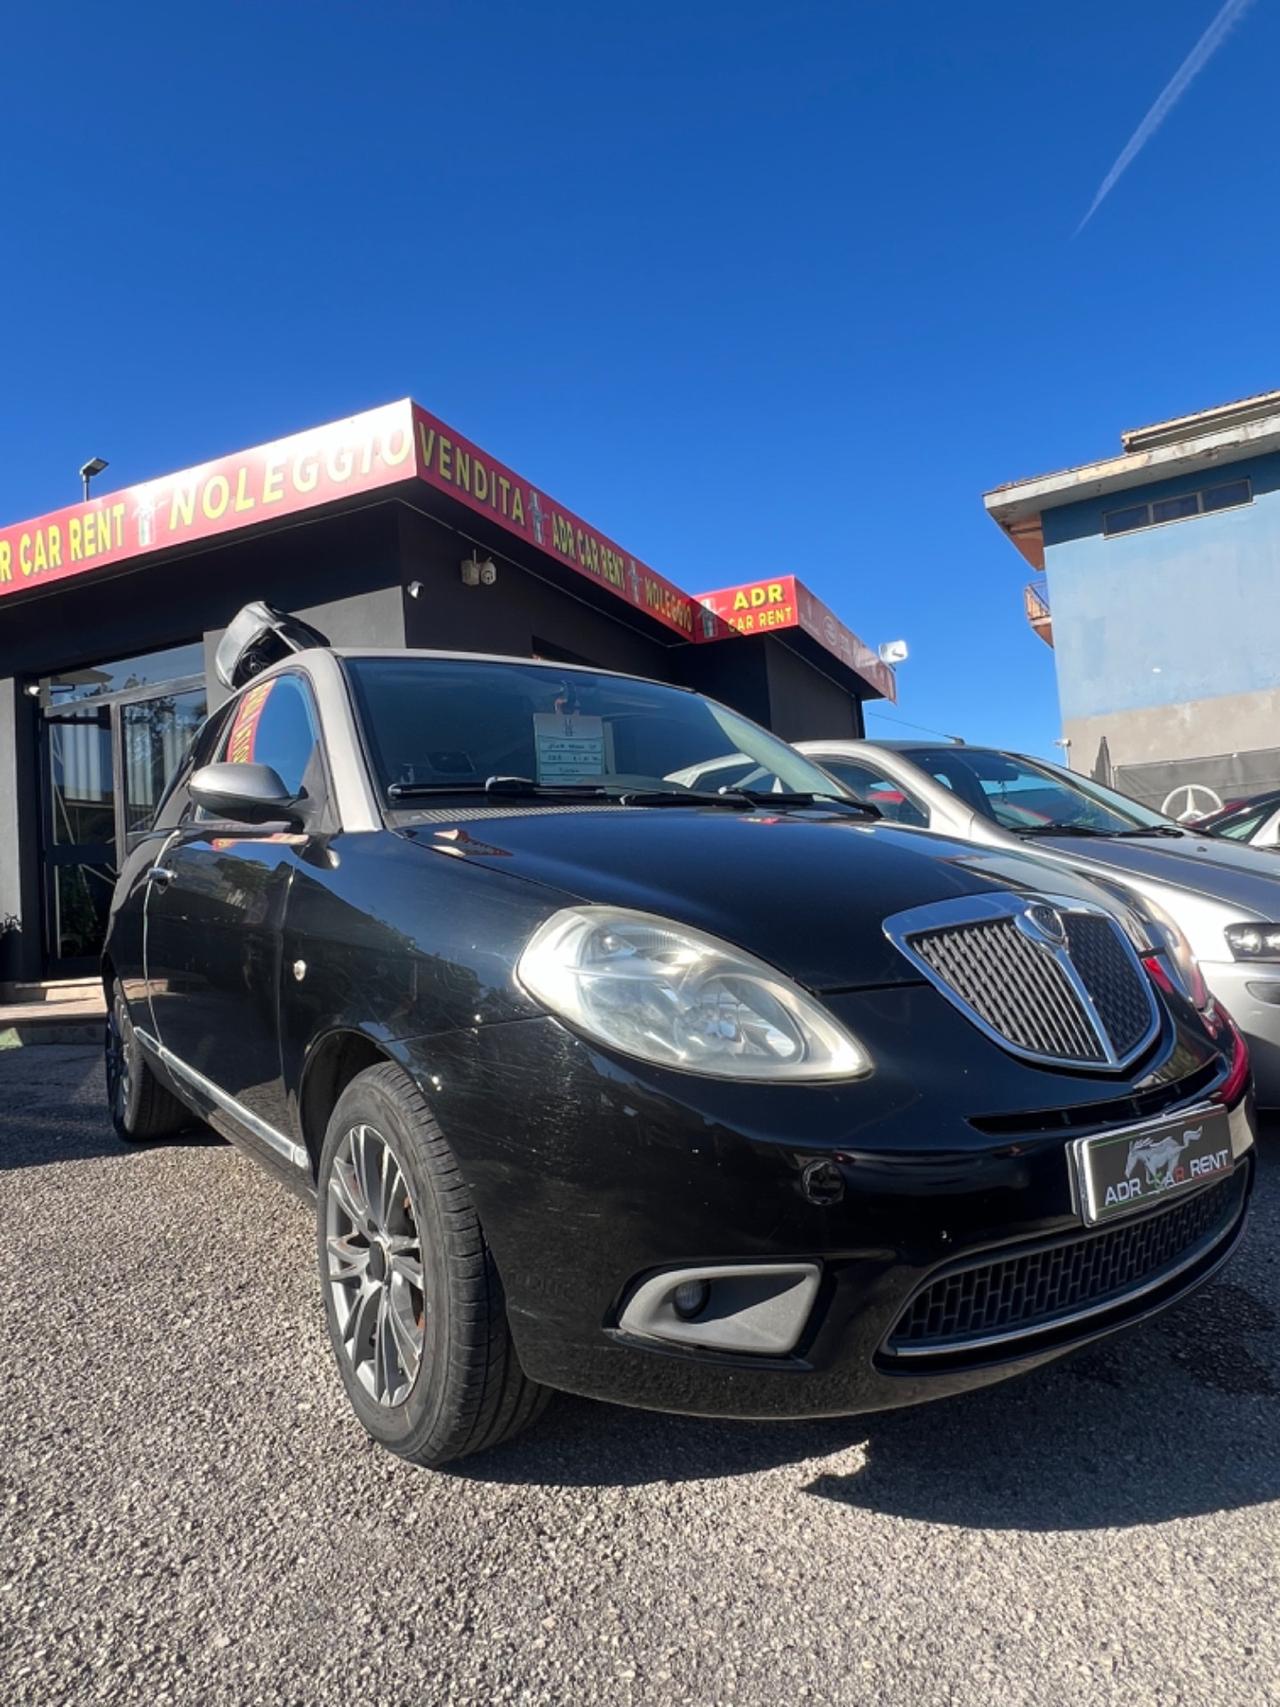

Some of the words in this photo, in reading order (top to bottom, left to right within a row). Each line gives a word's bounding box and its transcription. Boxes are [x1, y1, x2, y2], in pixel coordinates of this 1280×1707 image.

[168, 428, 411, 531] NOLEGGIO
[418, 421, 525, 526] VENDITA
[19, 529, 62, 577] CAR
[69, 502, 125, 561] RENT
[552, 511, 577, 560] ADR
[576, 529, 601, 576] CAR
[600, 544, 626, 593] RENT
[728, 614, 754, 633] CAR
[759, 606, 793, 627] RENT
[734, 583, 783, 610] ADR
[1104, 1178, 1142, 1206] ADR
[1190, 1149, 1229, 1177] RENT
